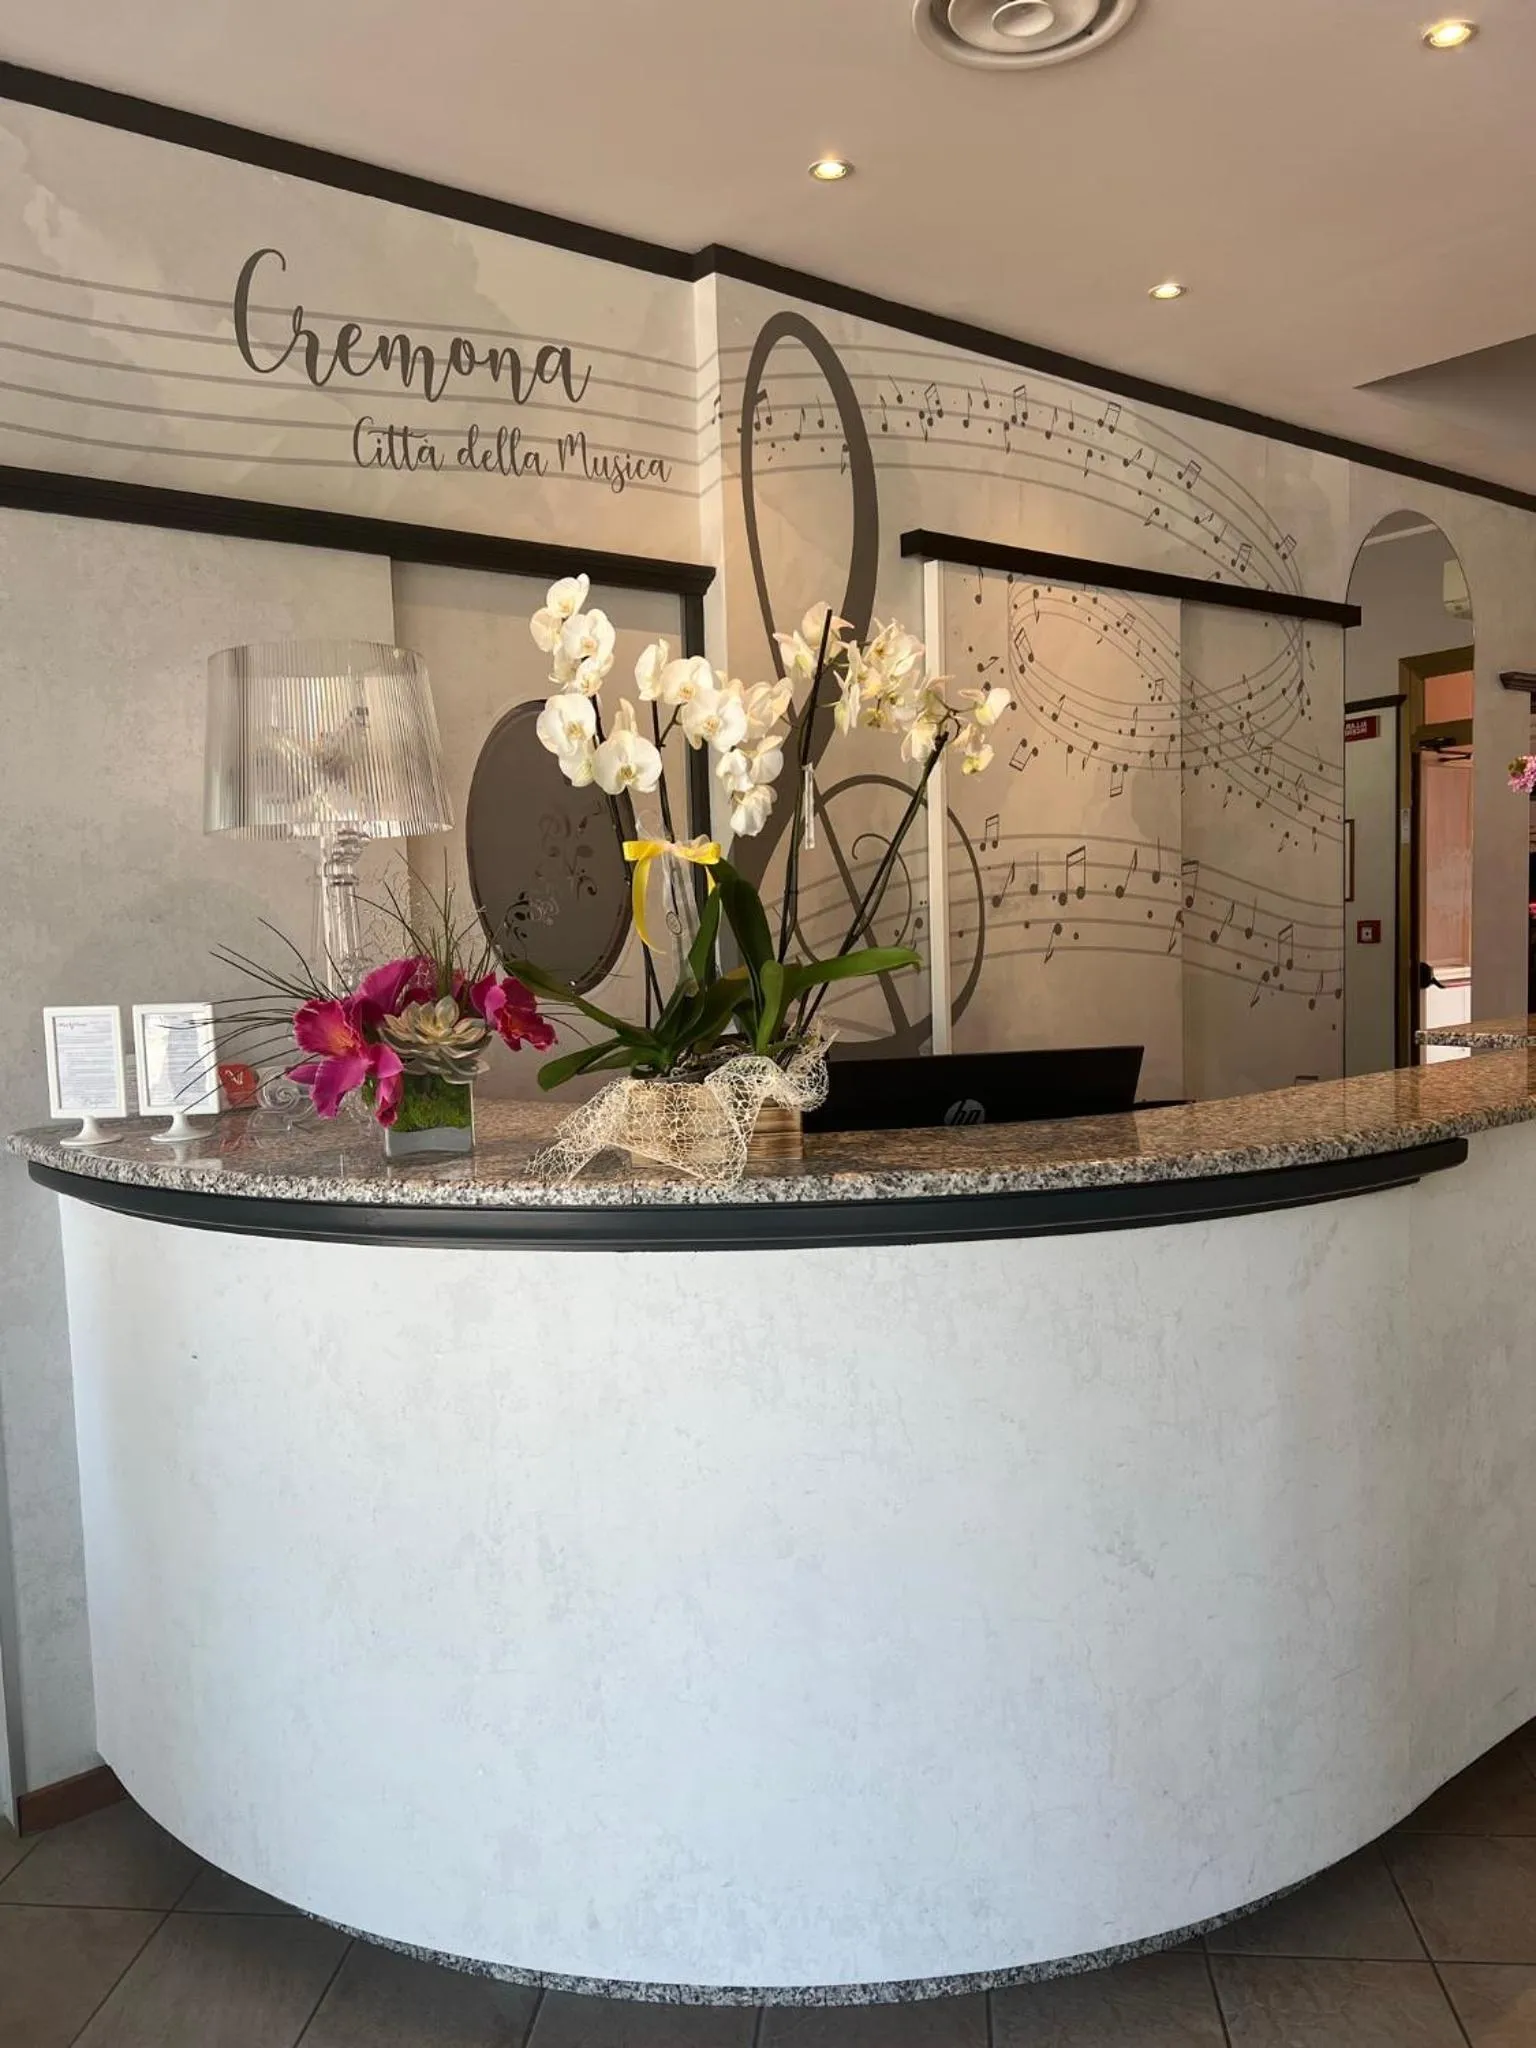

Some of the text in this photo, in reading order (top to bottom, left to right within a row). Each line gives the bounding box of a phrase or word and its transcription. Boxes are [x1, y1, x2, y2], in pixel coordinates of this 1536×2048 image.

[233, 248, 592, 404] Cremona
[352, 415, 672, 494] Città della Musica
